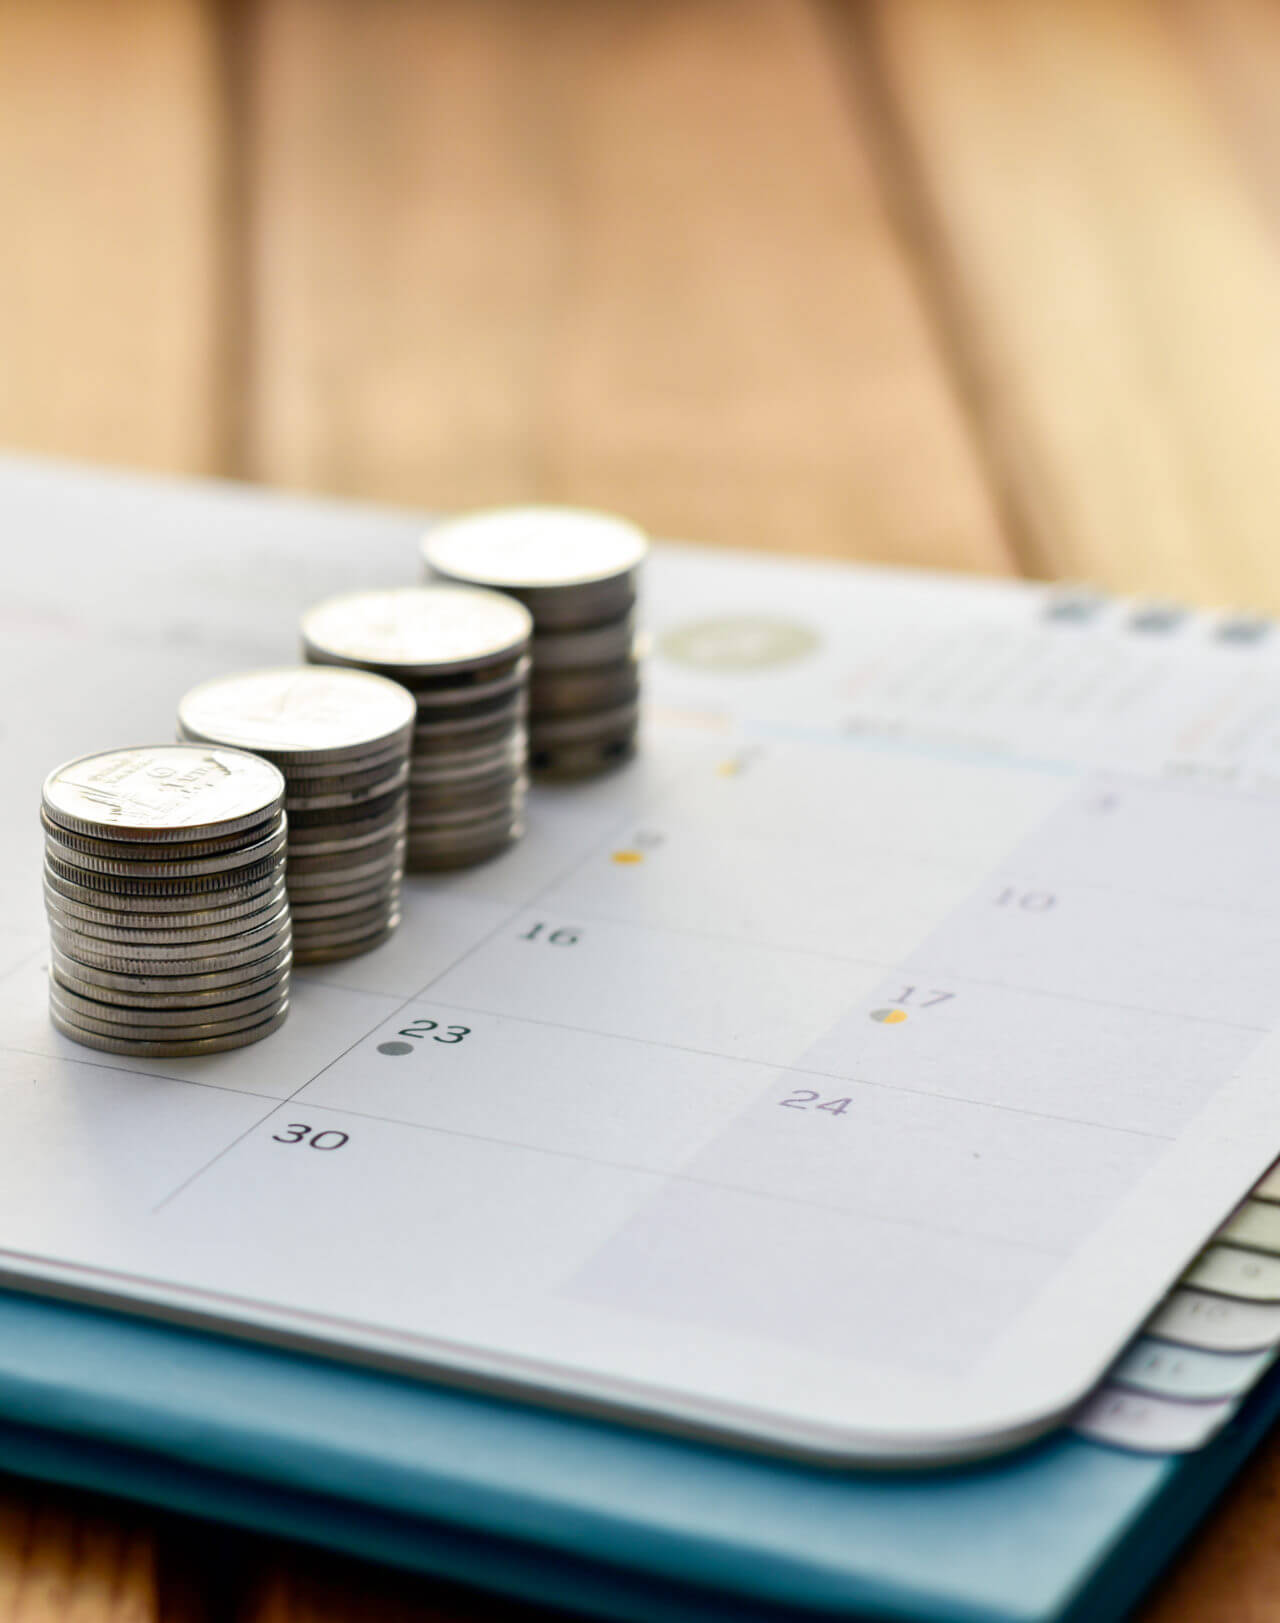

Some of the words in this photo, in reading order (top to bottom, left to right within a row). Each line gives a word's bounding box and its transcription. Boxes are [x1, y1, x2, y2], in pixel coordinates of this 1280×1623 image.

[992, 886, 1058, 912] 10
[519, 922, 584, 947] 16
[888, 985, 956, 1008] 17
[398, 1019, 472, 1044] 23
[778, 1089, 853, 1116] 24
[272, 1123, 350, 1151] 30
